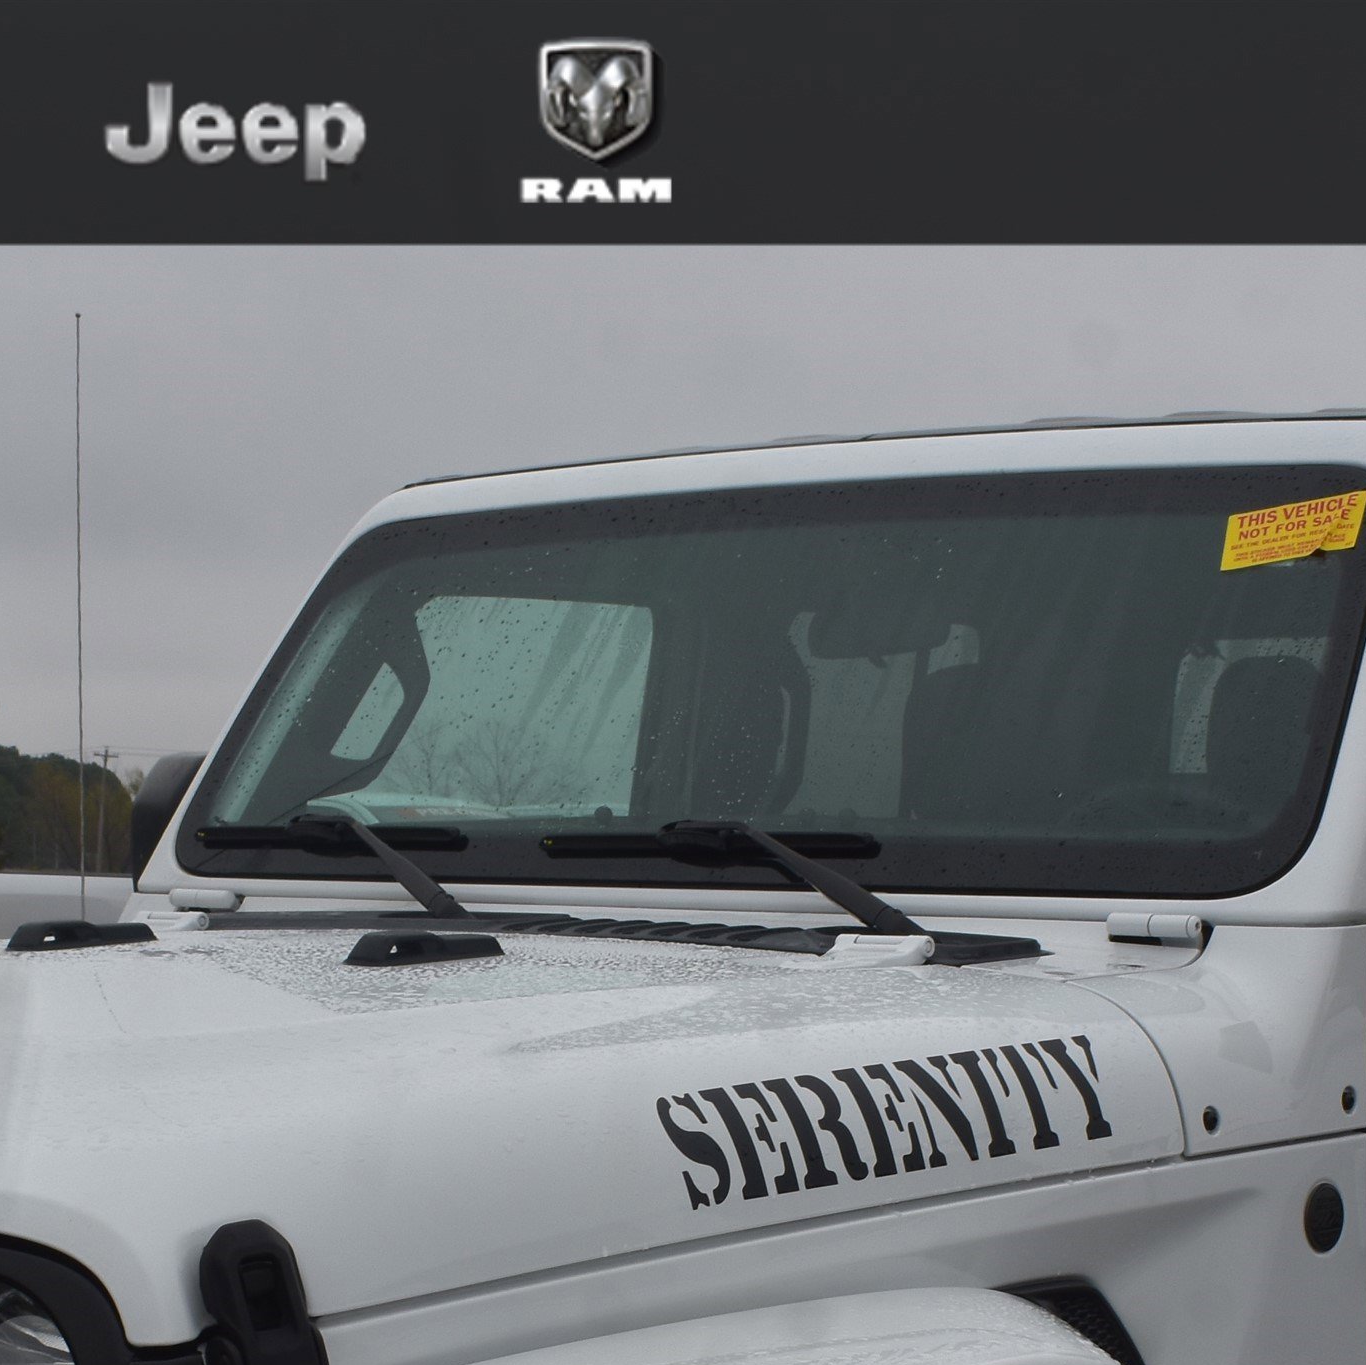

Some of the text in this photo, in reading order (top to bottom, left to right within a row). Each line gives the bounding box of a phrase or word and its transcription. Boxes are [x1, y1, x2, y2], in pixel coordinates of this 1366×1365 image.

[1237, 493, 1360, 530] THIS VEHICLE
[1239, 526, 1272, 541] NOT
[1276, 519, 1307, 534] FOR
[656, 1035, 1113, 1211] SERENITY
